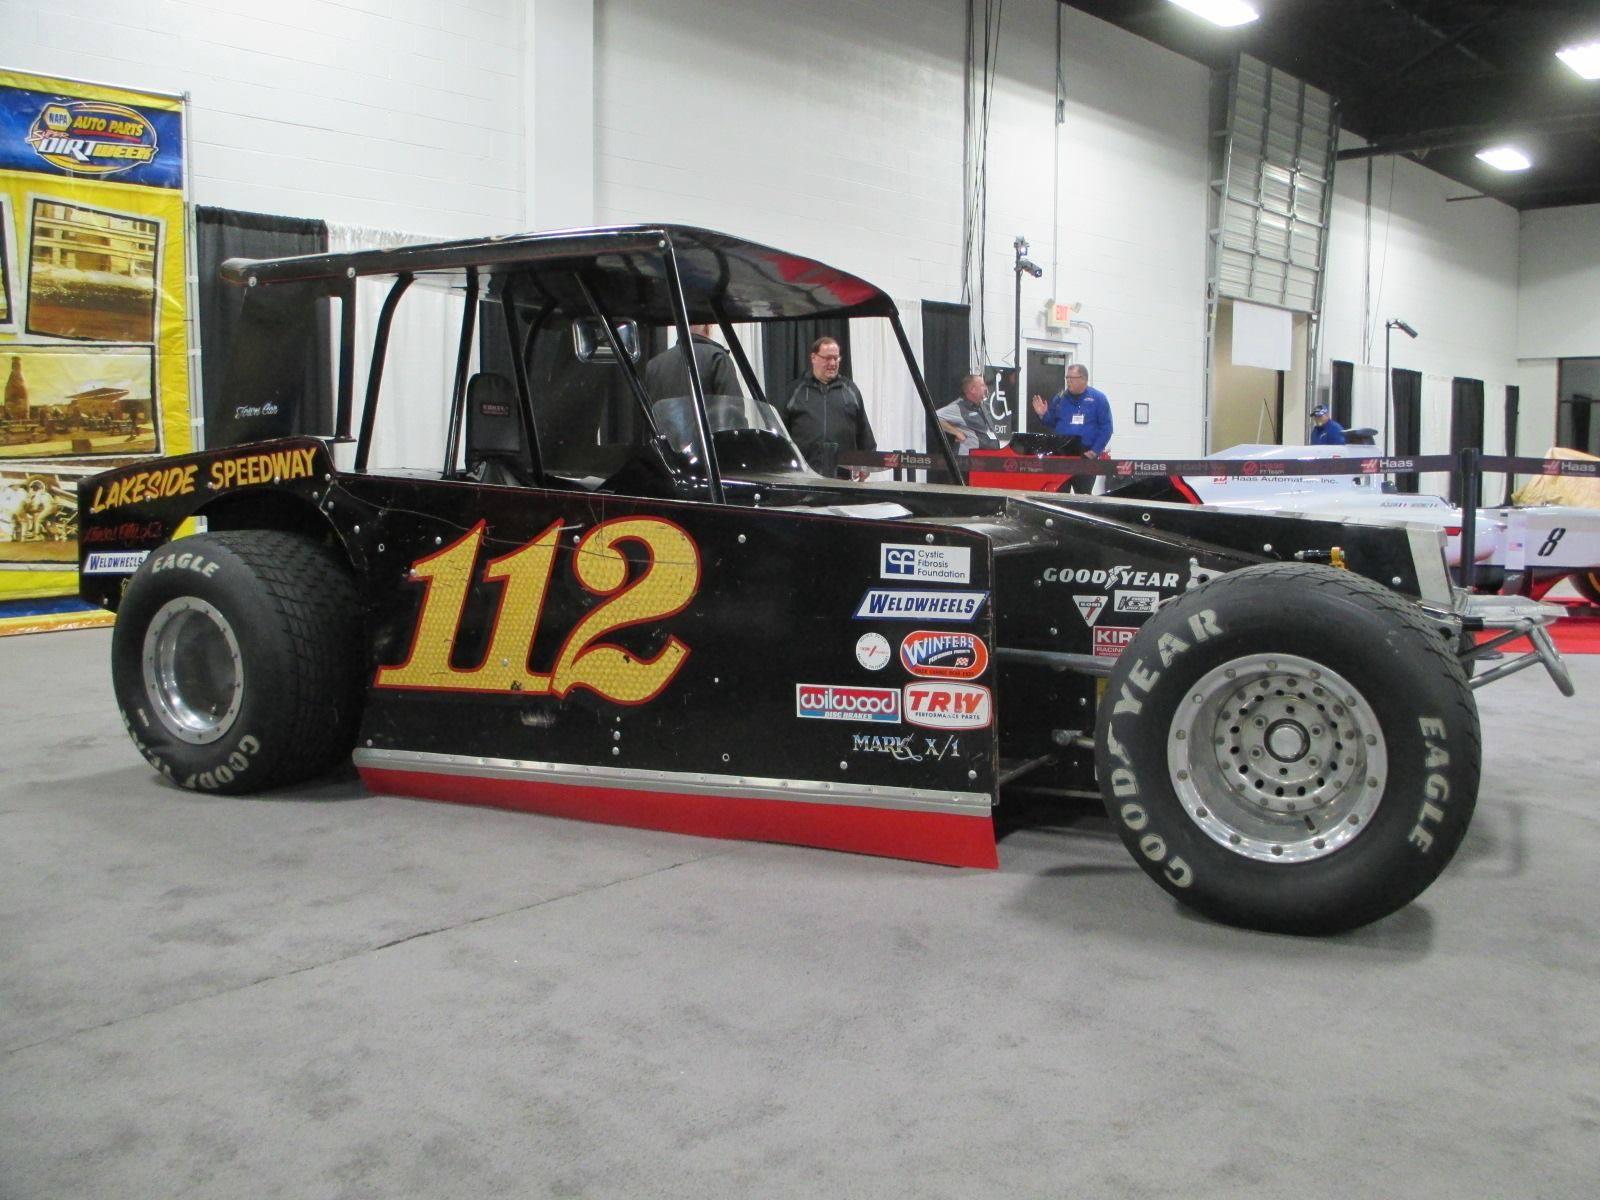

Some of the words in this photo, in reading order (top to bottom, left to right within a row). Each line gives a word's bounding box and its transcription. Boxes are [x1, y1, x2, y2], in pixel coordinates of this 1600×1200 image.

[48, 112, 68, 124] NAPA
[73, 116, 106, 131] AUTO
[109, 119, 144, 137] PARTS
[38, 137, 97, 161] DIRT
[994, 425, 1007, 434] EXIT
[901, 454, 931, 465] Haas
[1134, 462, 1167, 471] Haas
[1380, 458, 1413, 468] Haas
[1561, 461, 1597, 472] Haas
[93, 464, 199, 513] LAKESIDE
[211, 448, 317, 490] SPEEDWAY
[1537, 527, 1566, 557] 8
[90, 552, 143, 571] WELDWHEELS
[917, 559, 949, 568] Fibrosis
[918, 549, 945, 559] Cystic
[152, 552, 220, 578] EAGLE
[917, 568, 966, 579] Foundation
[373, 516, 701, 706] 112
[868, 593, 975, 614] WELDWHEELS
[1097, 630, 1137, 644] KIR
[903, 635, 975, 667] WINTERS
[800, 687, 895, 713] wilwood
[908, 690, 984, 715] TRW
[825, 711, 843, 719] DISC
[843, 712, 873, 720] BRAKES
[915, 711, 959, 720] PERFORMANCE
[961, 713, 980, 721] PARTS
[852, 731, 923, 762] MARK
[1417, 716, 1451, 854] EAGLE
